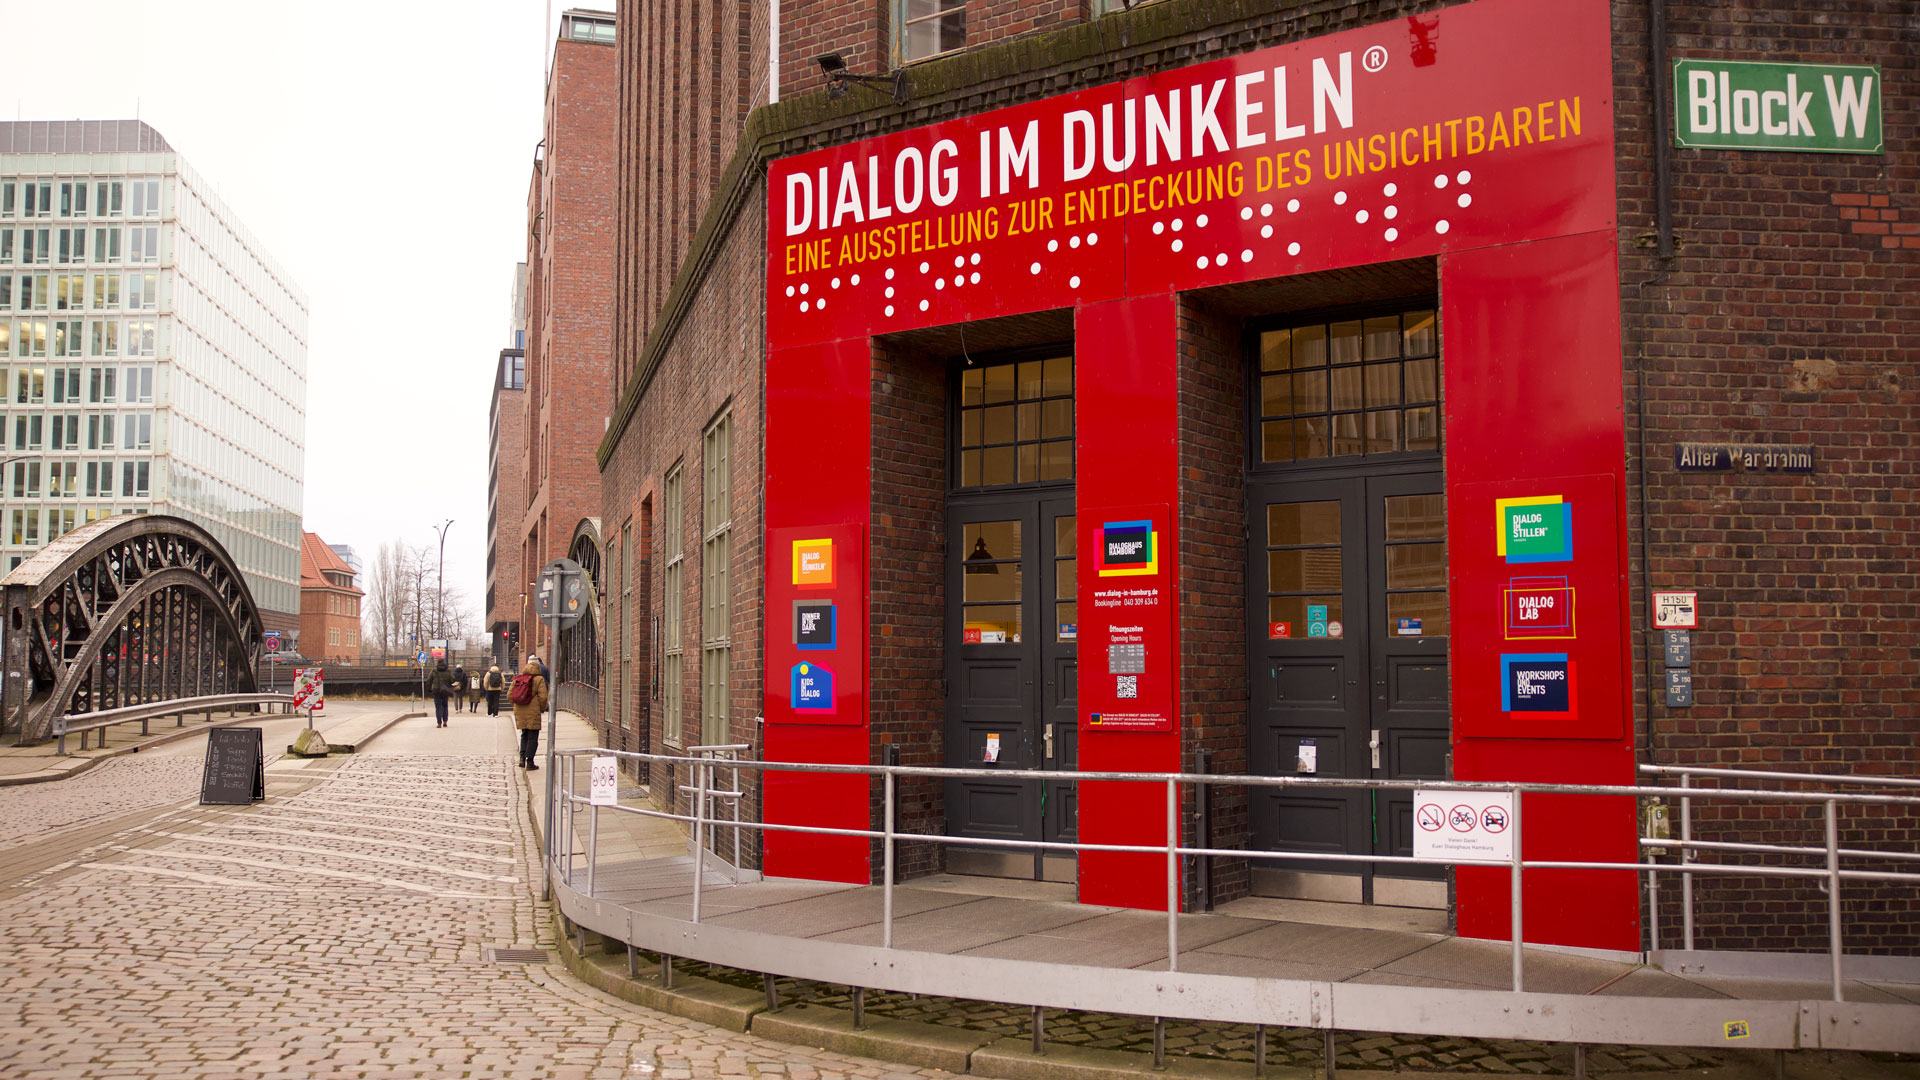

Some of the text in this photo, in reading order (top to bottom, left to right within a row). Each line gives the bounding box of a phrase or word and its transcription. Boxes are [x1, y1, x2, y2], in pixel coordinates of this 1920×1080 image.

[1688, 70, 1874, 139] Block W
[786, 139, 959, 237] DIALOG
[980, 119, 1039, 198] IM
[785, 95, 1582, 275] EINE AUSSTELLUNG ZUR ENTDECKUNG DES UNSICHTBAREN
[1680, 446, 1719, 467] Alter
[1512, 513, 1542, 524] DIALOG
[1095, 599, 1122, 608] Bookingline
[1518, 596, 1554, 609] DIALOG
[1519, 607, 1539, 620] LAB
[1109, 624, 1144, 634] Öffnungszeiten
[1111, 634, 1142, 643] Opening Hours
[1671, 633, 1678, 643] S
[1516, 670, 1565, 681] WORKSHOPS
[801, 678, 814, 686] KIDS
[1517, 685, 1546, 695] EVENTS
